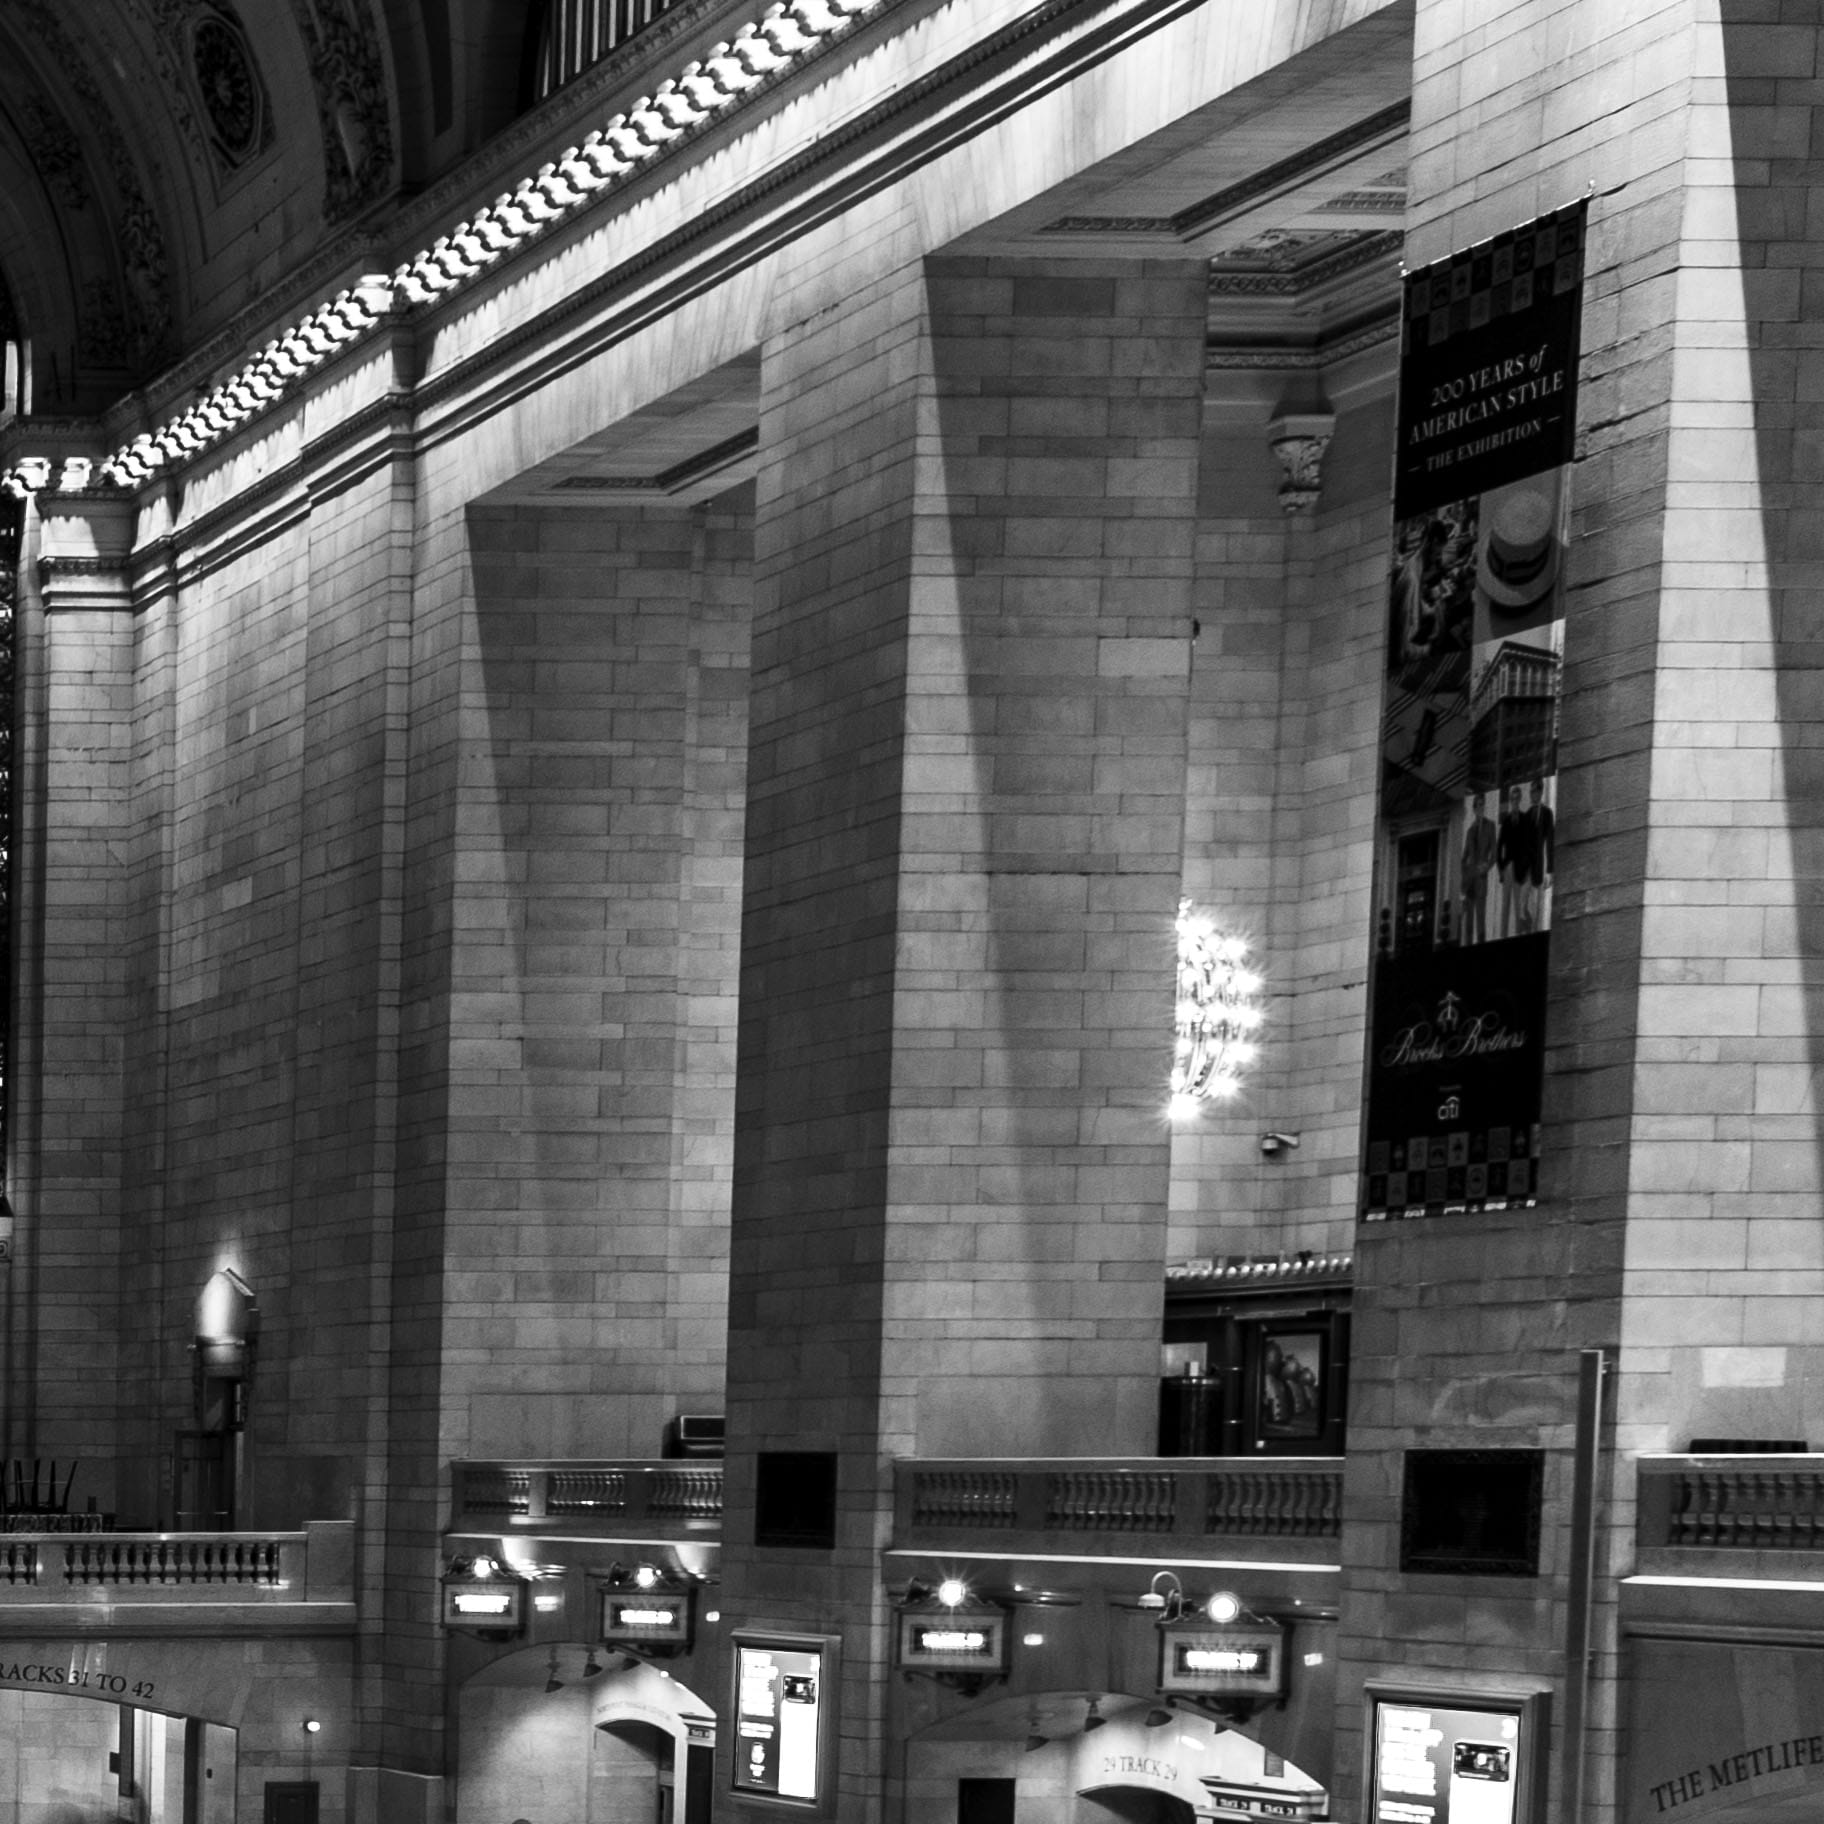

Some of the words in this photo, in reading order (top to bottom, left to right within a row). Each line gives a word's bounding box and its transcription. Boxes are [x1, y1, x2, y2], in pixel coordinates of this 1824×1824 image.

[1429, 378, 1466, 409] 200
[1468, 353, 1526, 393] YEARS
[1528, 343, 1550, 374] of
[1408, 392, 1503, 447] AMERICAN
[1505, 369, 1565, 411] STYLE
[1426, 450, 1454, 472] THE
[1456, 417, 1542, 462] EXHIBITION
[67, 1670, 89, 1688] 31
[95, 1672, 127, 1694] TO
[131, 1681, 155, 1699] 42
[1120, 1755, 1161, 1777] TRACK
[1650, 1770, 1705, 1814] THE
[1706, 1735, 1824, 1792] METLIFE
